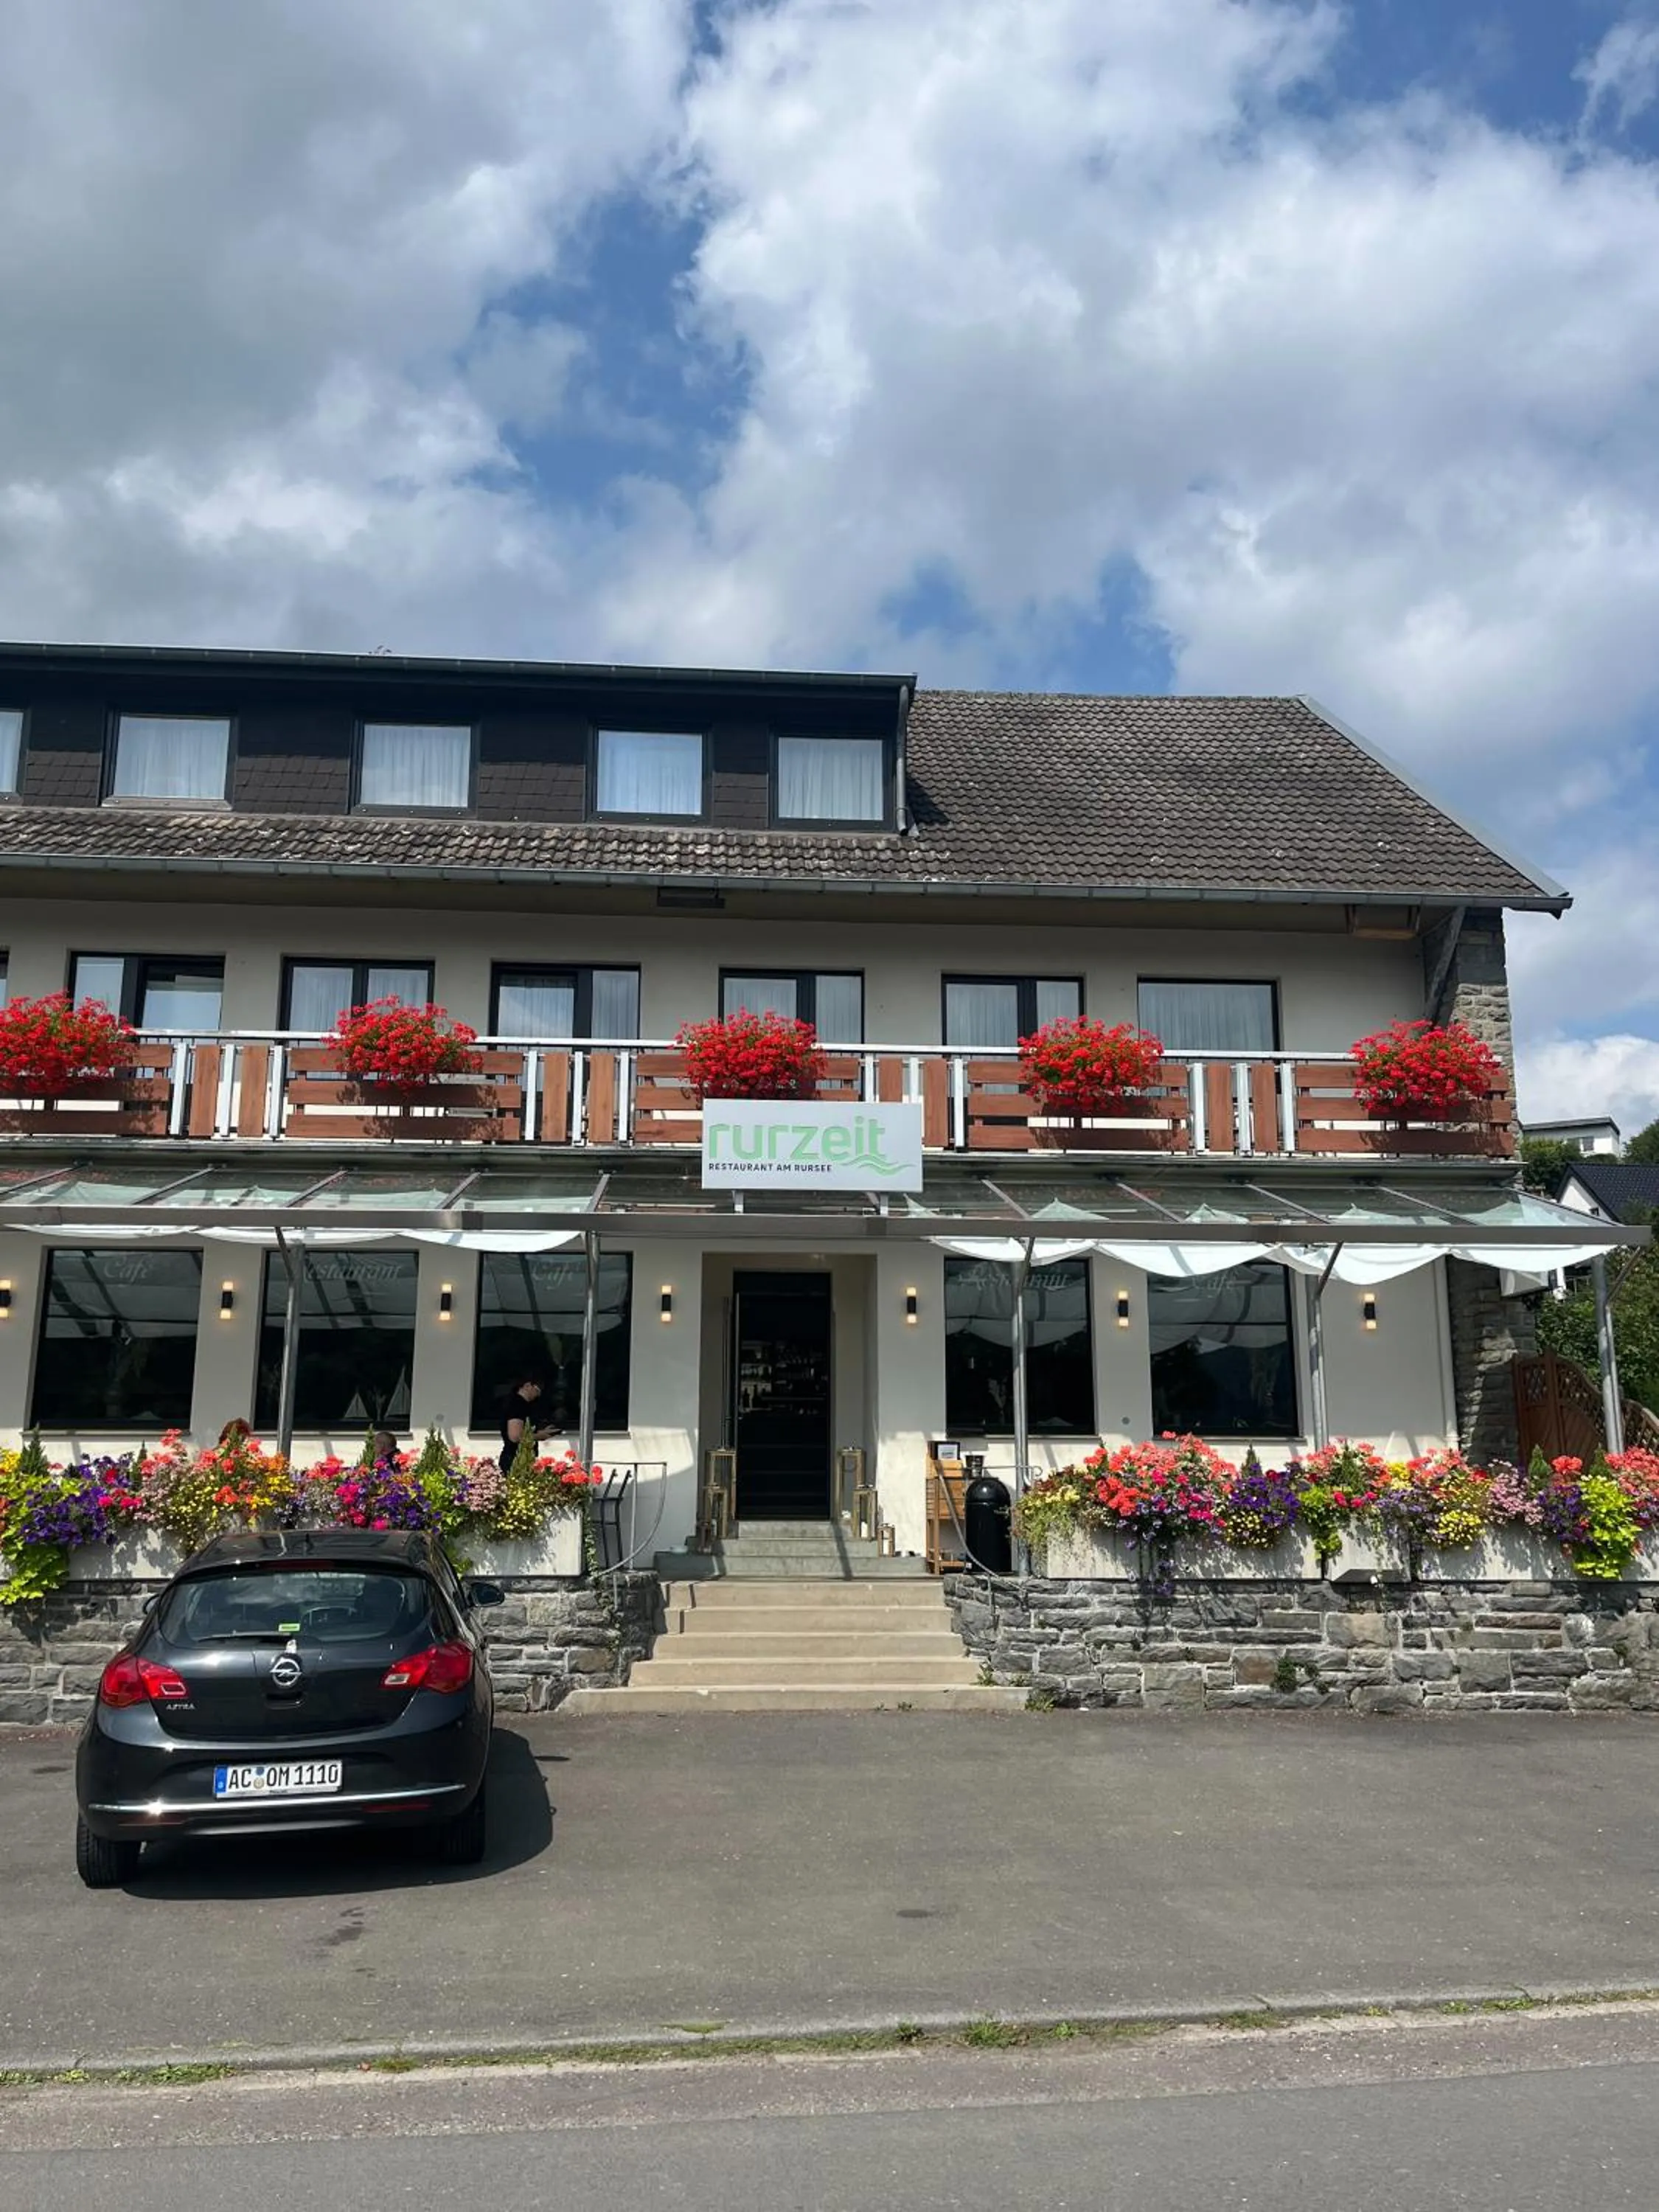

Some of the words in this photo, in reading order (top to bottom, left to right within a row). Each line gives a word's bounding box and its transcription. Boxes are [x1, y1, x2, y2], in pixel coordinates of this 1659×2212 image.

[709, 1115, 886, 1161] rurzeit
[709, 1163, 773, 1172] RESTAURANT
[776, 1164, 791, 1172] AM
[794, 1164, 832, 1172] RURSEE
[303, 1256, 402, 1283] estaurant
[229, 1768, 251, 1789] AC
[266, 1767, 290, 1787] OM
[295, 1764, 338, 1784] 1110
